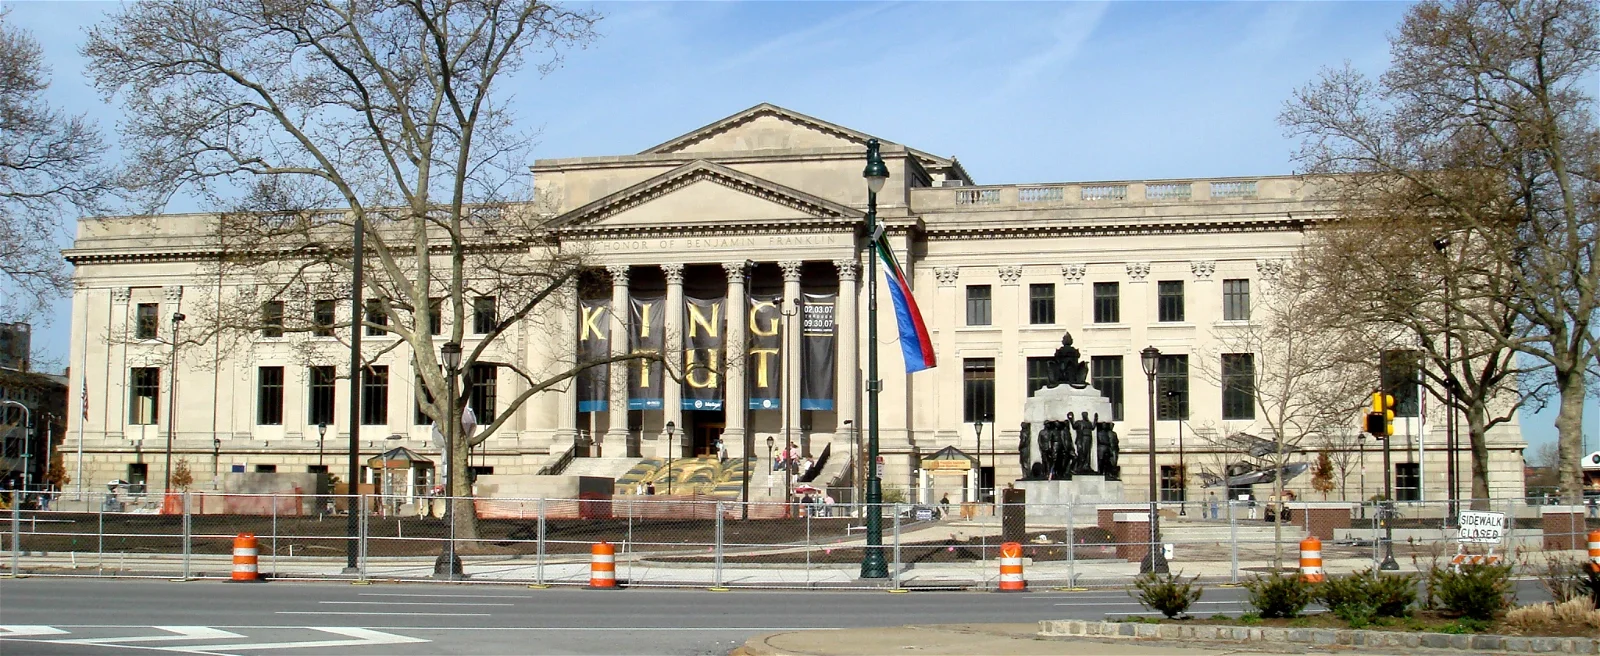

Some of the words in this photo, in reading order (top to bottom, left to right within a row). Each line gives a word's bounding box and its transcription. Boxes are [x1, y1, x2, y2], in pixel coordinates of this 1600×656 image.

[604, 241, 648, 250] HONOR
[660, 240, 675, 249] OF
[687, 238, 755, 249] BENJAMIN
[769, 235, 835, 246] FRANKLIN
[804, 305, 833, 314] 02.03.07
[804, 319, 833, 327] 09.30.07
[1461, 515, 1502, 527] SIDEWALK
[1461, 528, 1499, 539] CLOSED
